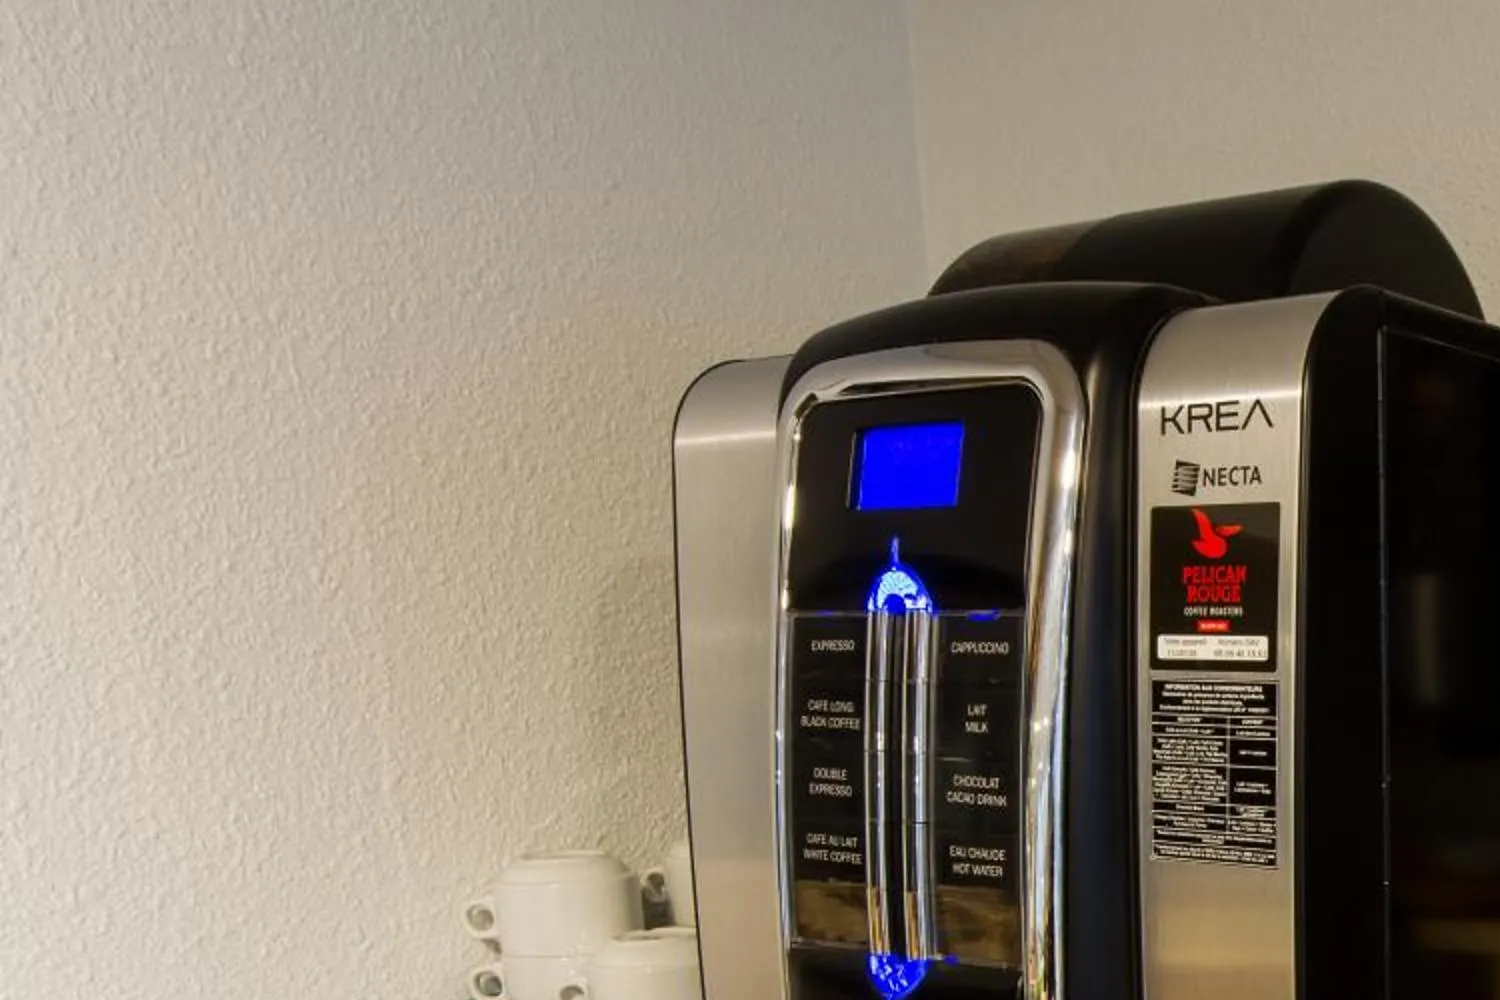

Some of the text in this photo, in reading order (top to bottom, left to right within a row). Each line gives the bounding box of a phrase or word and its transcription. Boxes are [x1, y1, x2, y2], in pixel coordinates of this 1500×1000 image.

[1202, 465, 1263, 488] NECTA
[1183, 565, 1247, 584] PELICAN
[1186, 585, 1241, 603] ROUGE
[811, 639, 855, 652] EXPRESSO
[951, 641, 1010, 655] CAPPUCCINO
[967, 703, 988, 717] LAIT
[801, 715, 861, 731] BLACK COFFEE
[964, 721, 989, 734] MILK
[813, 767, 848, 781] DOUBLE
[953, 774, 1000, 789] CHOCOLAT
[808, 782, 853, 797] EXPRESSO
[946, 791, 1007, 807] CACAO DRINK
[803, 849, 863, 865] WHITE COFFEE
[949, 845, 1007, 861] EAU CHAUDE
[952, 863, 1003, 877] HOT WATER
